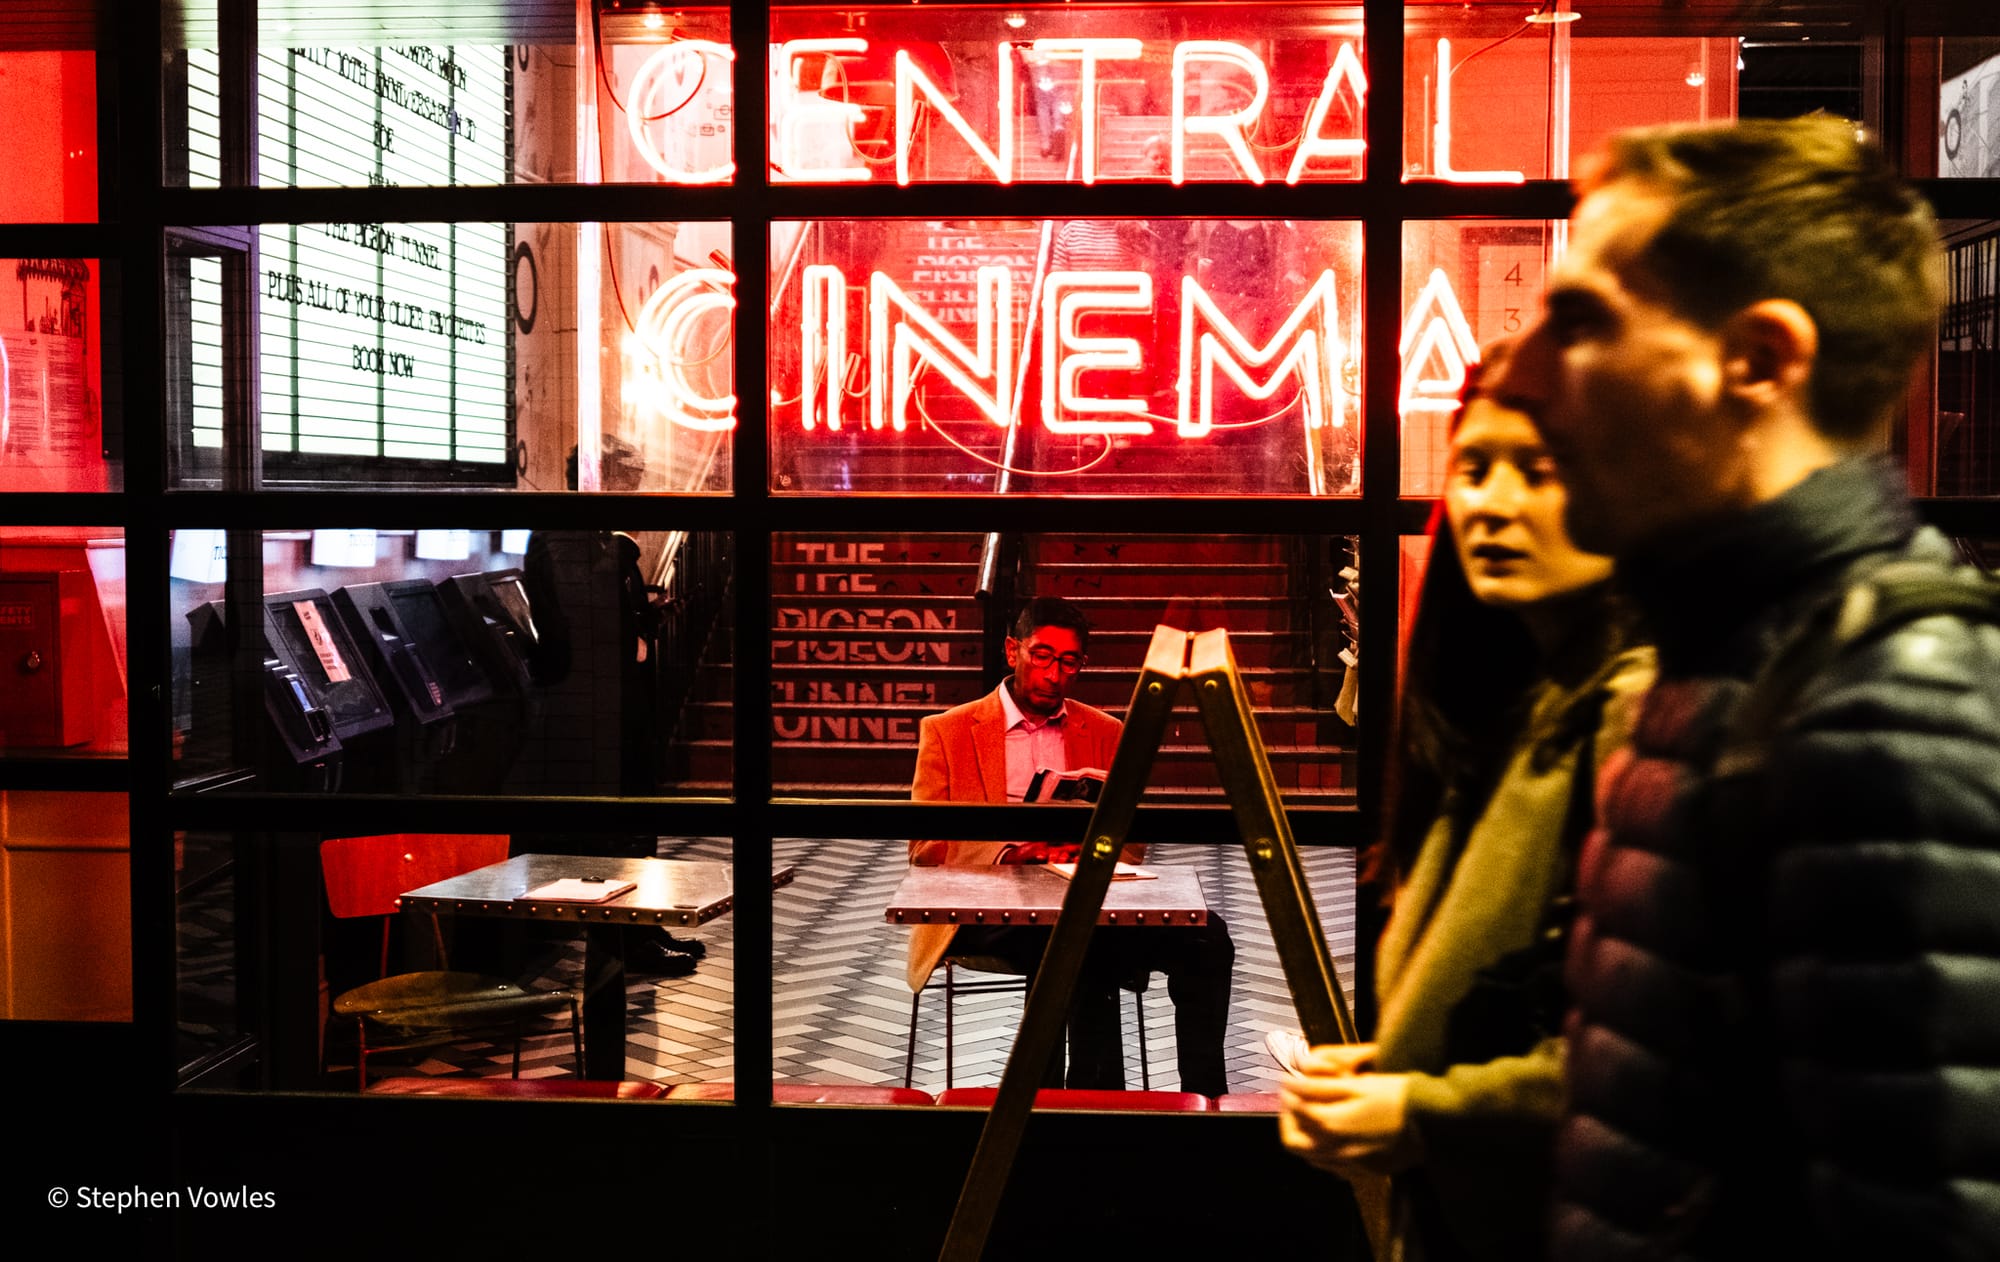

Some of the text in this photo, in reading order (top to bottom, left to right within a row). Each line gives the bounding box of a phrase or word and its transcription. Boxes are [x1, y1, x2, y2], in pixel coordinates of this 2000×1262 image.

[626, 37, 1525, 185] CENTRAL
[401, 235, 441, 270] TUNNEL
[1503, 261, 1523, 287] 4
[268, 270, 486, 344] PLUS ALL OF YOUR OLDER FAVOURITES
[1503, 308, 1522, 333] 3
[352, 344, 415, 378] BOOK NOW
[634, 264, 1482, 438] CINEMA
[771, 608, 957, 664] PIGEON
[771, 682, 936, 742] UNNEL
